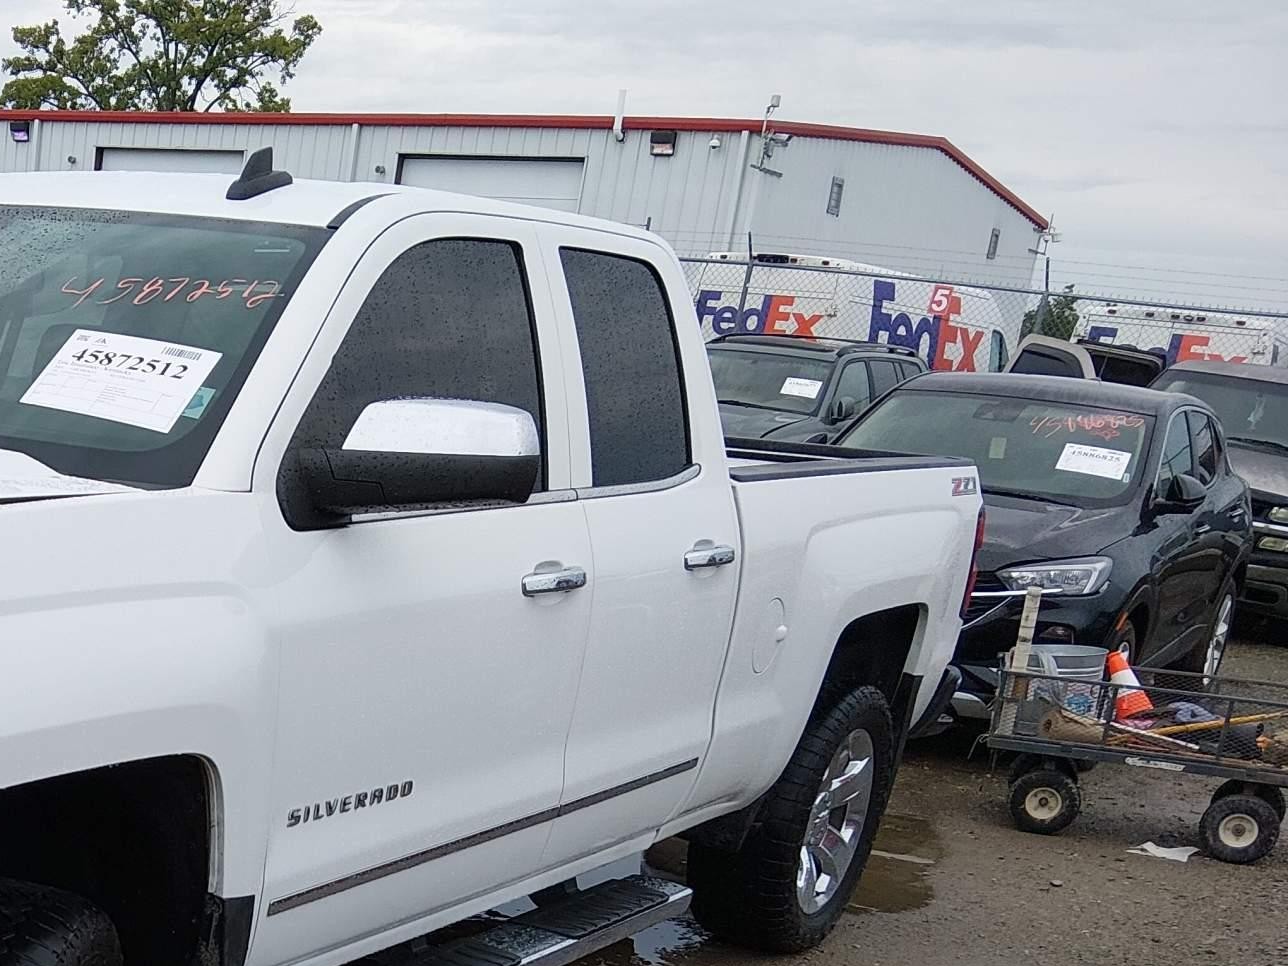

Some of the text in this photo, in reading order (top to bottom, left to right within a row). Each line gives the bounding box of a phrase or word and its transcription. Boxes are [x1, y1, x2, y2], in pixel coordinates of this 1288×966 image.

[62, 276, 285, 309] 45872512
[931, 289, 951, 312] 5
[696, 290, 824, 342] FedEx
[72, 348, 189, 380] 45872512
[952, 477, 977, 496] Z71
[286, 780, 414, 828] SILVERADO
